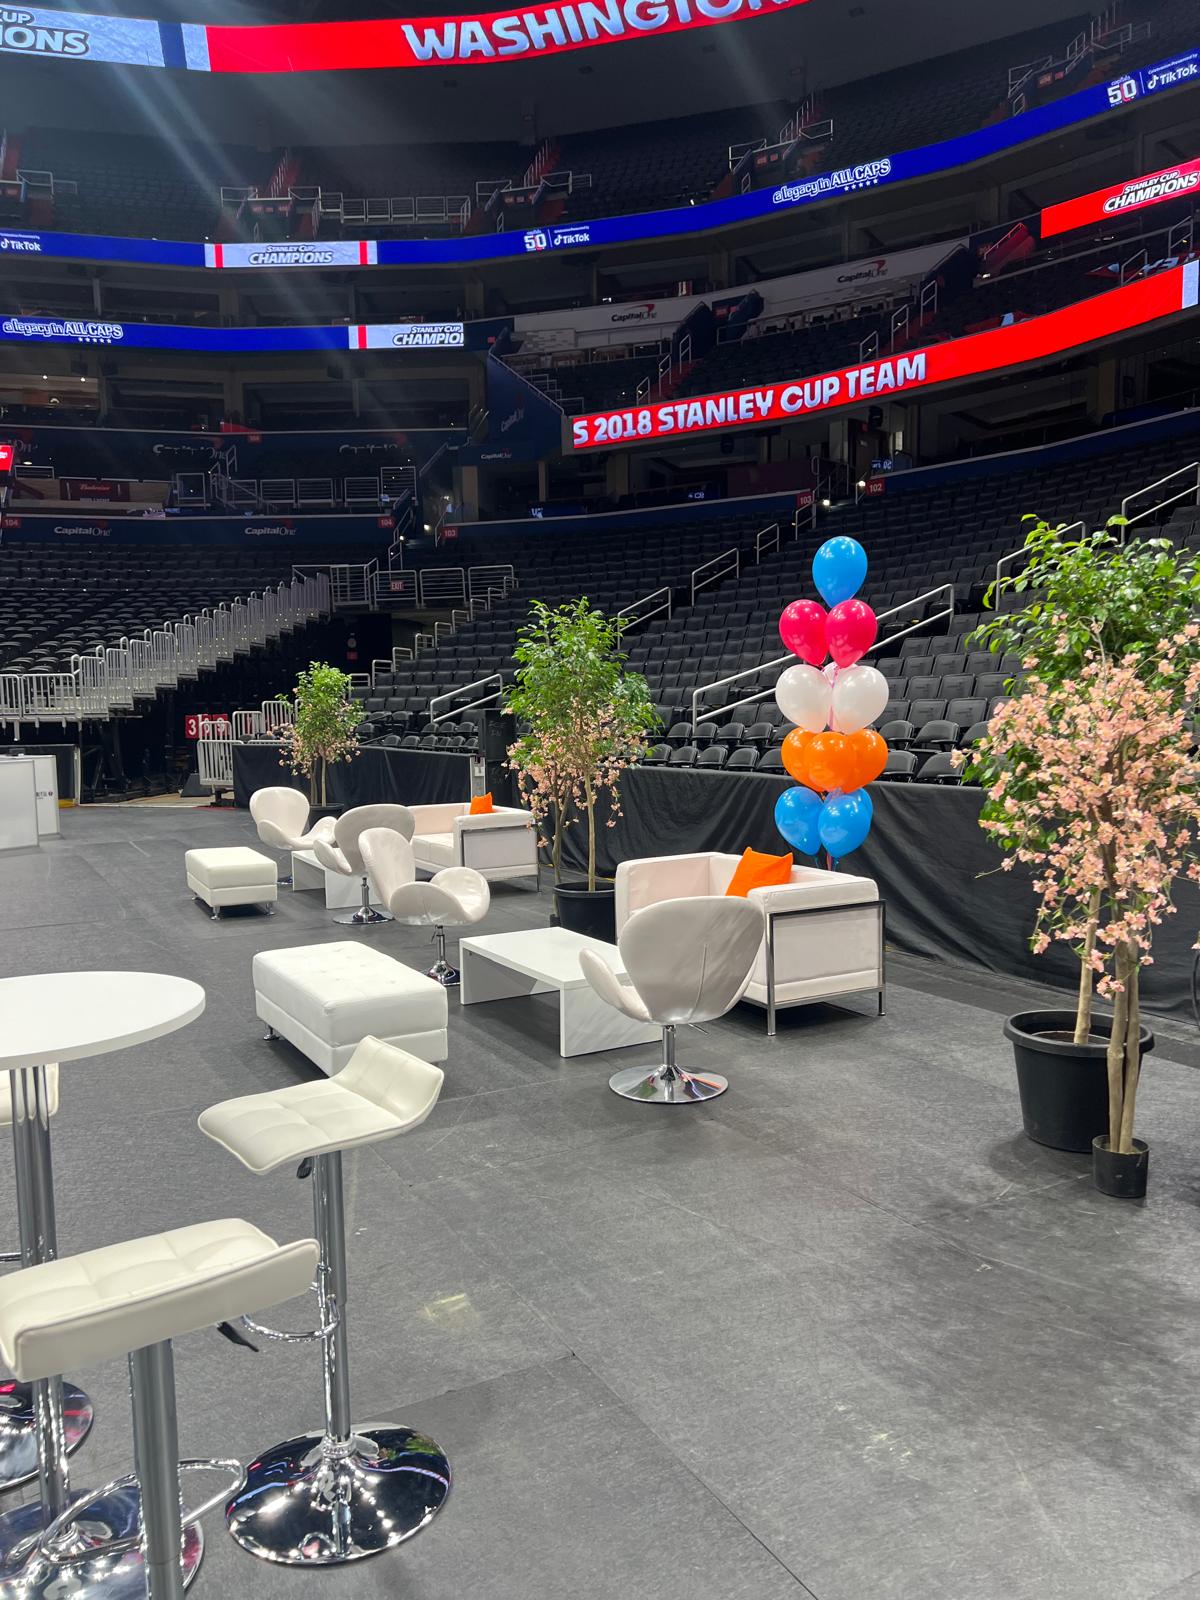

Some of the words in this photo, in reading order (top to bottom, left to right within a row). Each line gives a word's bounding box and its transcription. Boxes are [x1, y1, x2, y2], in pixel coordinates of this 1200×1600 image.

[0, 10, 31, 23] UP
[400, 0, 789, 61] WASHINGT
[1160, 64, 1198, 85] TikTok
[1107, 79, 1137, 104] 50
[782, 181, 818, 201] legacy
[831, 169, 854, 187] ALL
[854, 159, 890, 180] CAPS
[1125, 177, 1159, 194] STANLEY
[1159, 171, 1178, 183] CUP
[1104, 173, 1198, 211] CHAMPIONS
[11, 241, 42, 251] TikTok
[524, 233, 547, 249] 50
[563, 233, 590, 244] TikTok
[249, 252, 333, 264] CHAMPIONS
[12, 319, 51, 337] legacy
[64, 322, 87, 336] ALL
[87, 324, 123, 338] CAPS
[444, 325, 461, 333] CUP
[594, 410, 651, 442] 2018
[658, 390, 774, 432] STANLEY
[781, 377, 840, 413] CUP
[846, 353, 926, 399] TEAM
